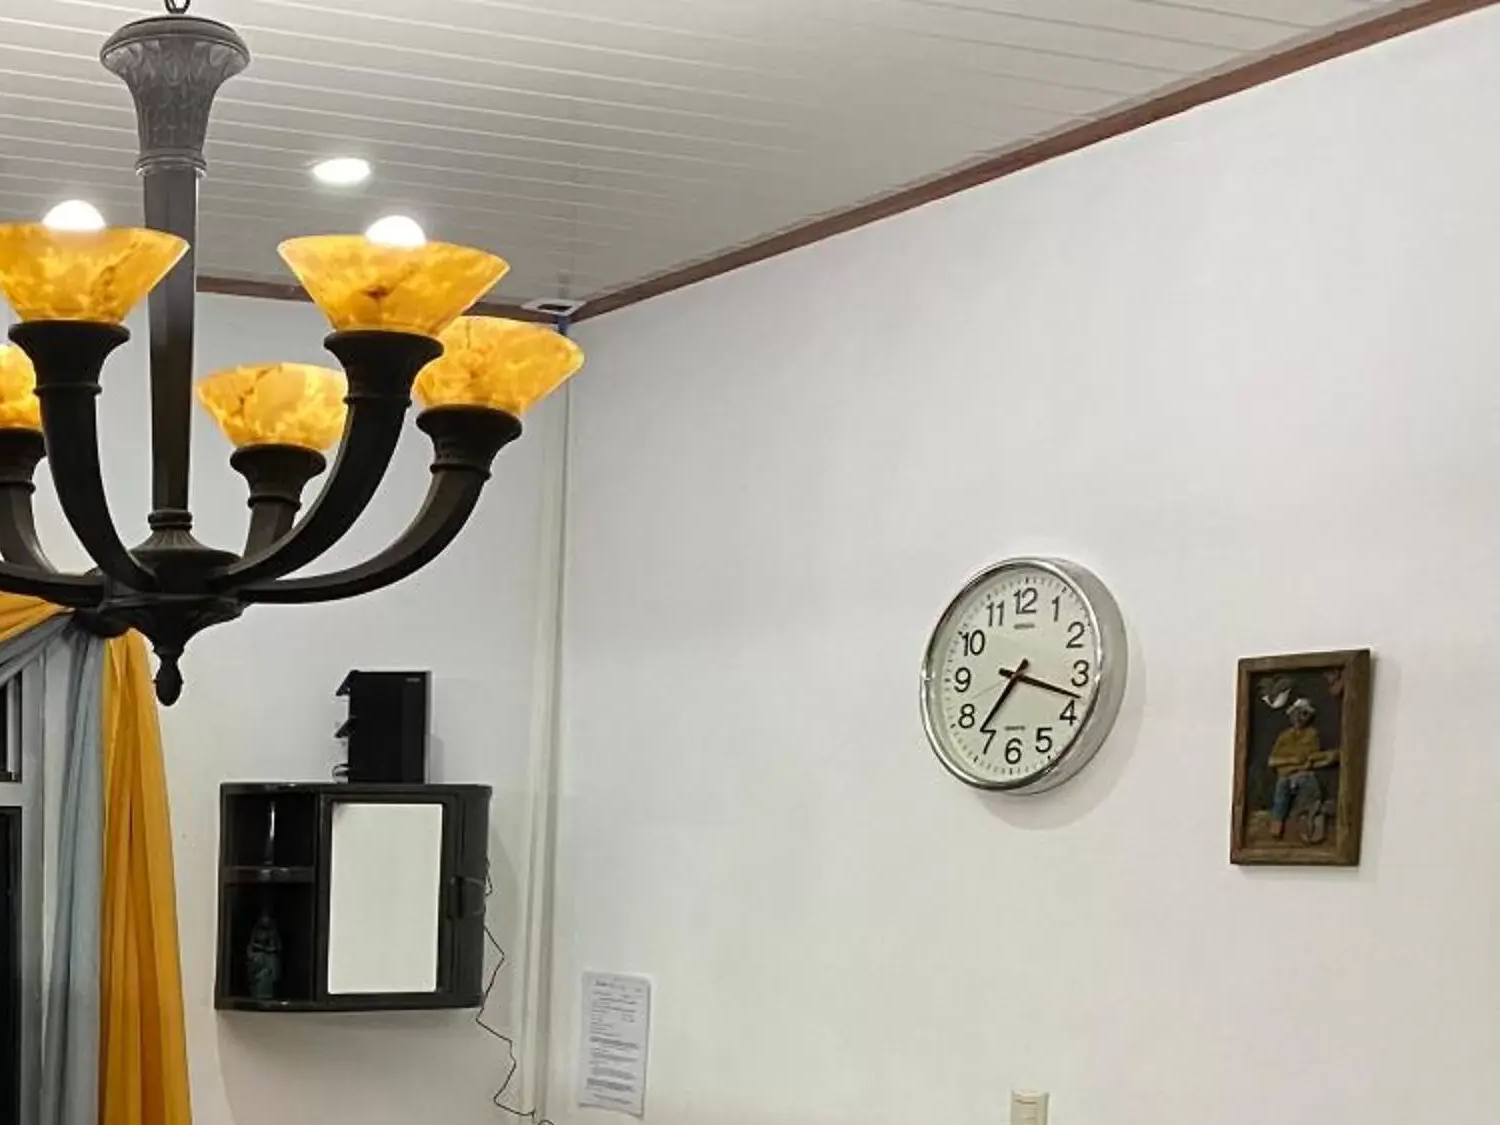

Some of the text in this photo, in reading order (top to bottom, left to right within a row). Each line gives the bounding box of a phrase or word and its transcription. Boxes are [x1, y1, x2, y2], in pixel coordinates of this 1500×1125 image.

[986, 601, 1005, 627] 11
[1014, 588, 1038, 614] 12
[1052, 596, 1060, 622] 1
[962, 629, 985, 656] 10
[1067, 622, 1085, 648] 2
[955, 667, 971, 692] 9
[1072, 660, 1089, 687] 3
[958, 704, 975, 728] 8
[1060, 700, 1077, 726] 4
[980, 729, 996, 754] 7
[1005, 738, 1022, 764] 6
[1035, 728, 1053, 753] 5
